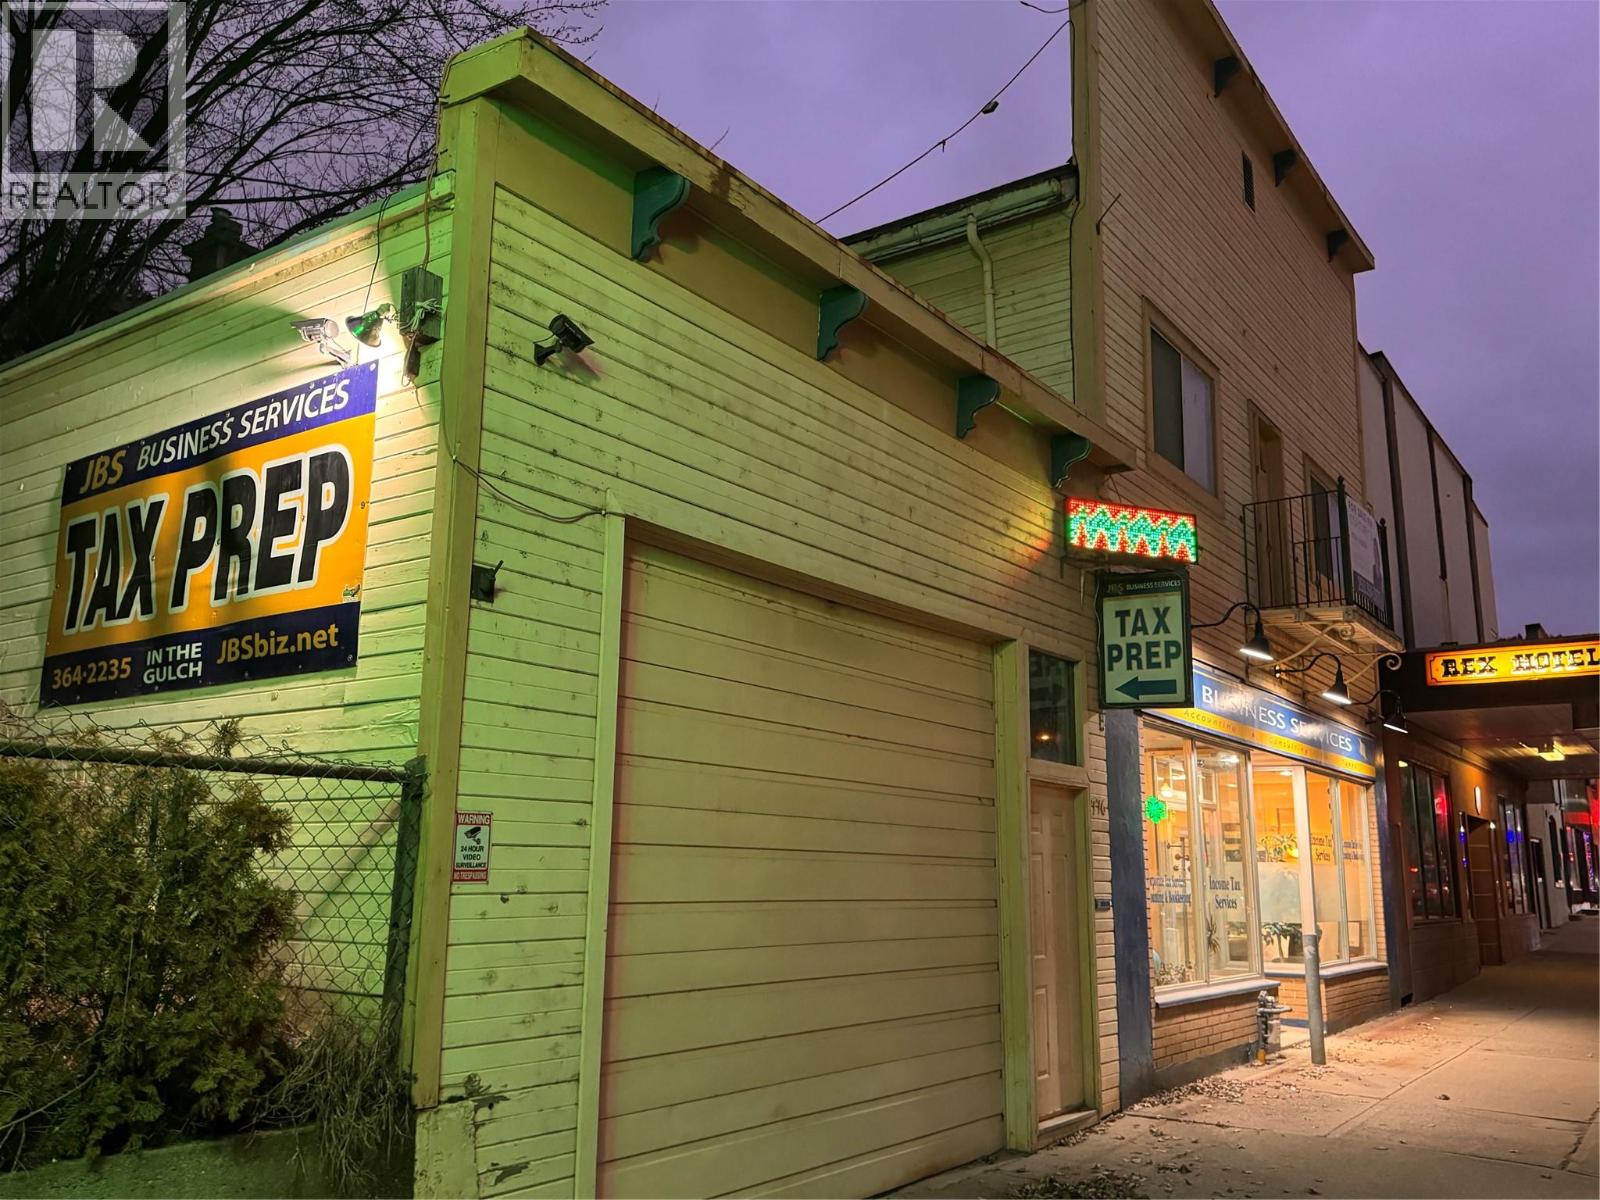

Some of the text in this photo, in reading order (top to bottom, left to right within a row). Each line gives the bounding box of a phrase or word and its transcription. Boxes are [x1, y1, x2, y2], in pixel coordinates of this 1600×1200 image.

[80, 379, 350, 494] JBS BUSINESS SERVICES
[63, 443, 355, 635] TAX PREP
[1126, 581, 1153, 591] BUSINESS
[216, 623, 339, 665] JBSbiz.net
[1107, 606, 1183, 672] TAX PREP
[147, 642, 202, 666] IN THE
[1441, 647, 1600, 678] REX HOTEL
[143, 662, 202, 685] GULCH
[457, 814, 490, 825] WARNING
[463, 853, 481, 861] VIDEO
[468, 845, 484, 853] HOUR
[1209, 875, 1241, 891] Income Tax
[1215, 894, 1238, 909] Services
